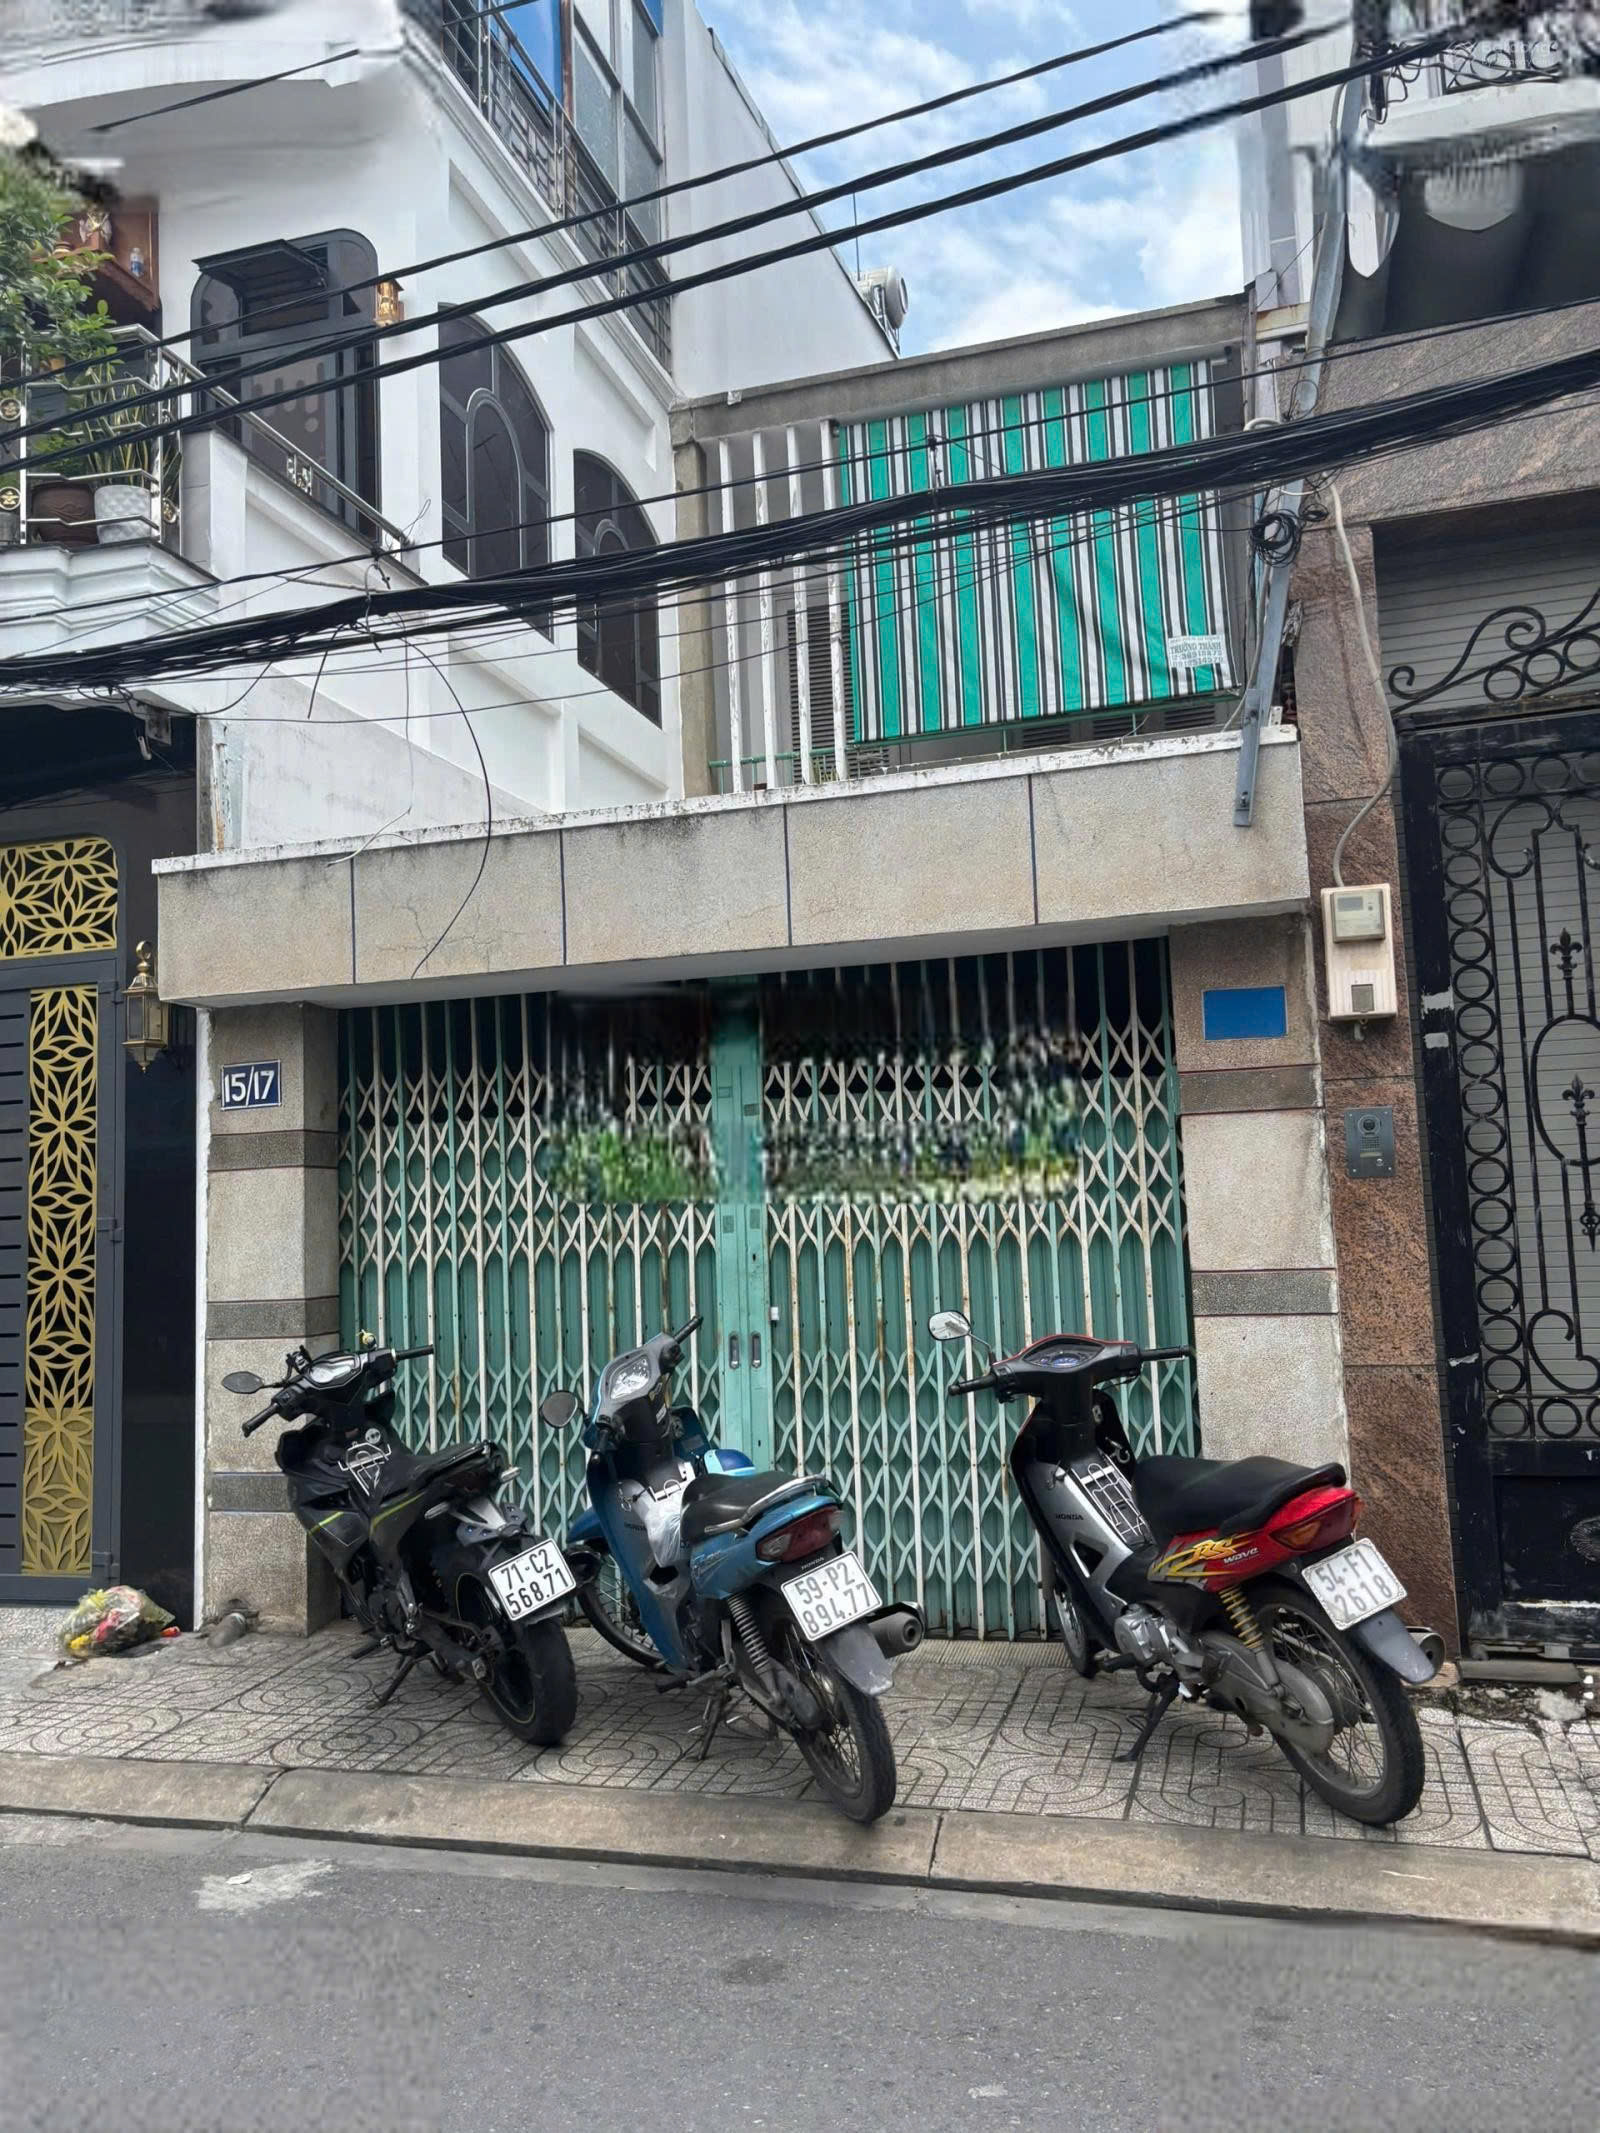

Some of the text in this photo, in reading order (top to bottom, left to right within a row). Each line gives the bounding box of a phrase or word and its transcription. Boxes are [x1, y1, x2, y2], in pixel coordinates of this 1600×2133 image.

[224, 1066, 275, 1107] 15/17
[500, 1548, 554, 1590] 71-C2
[794, 1562, 855, 1604] 59-P2
[1315, 1549, 1373, 1592] 54-F1
[505, 1568, 569, 1615] 568.71
[802, 1582, 870, 1633] 894.77
[1334, 1575, 1392, 1623] 2618
